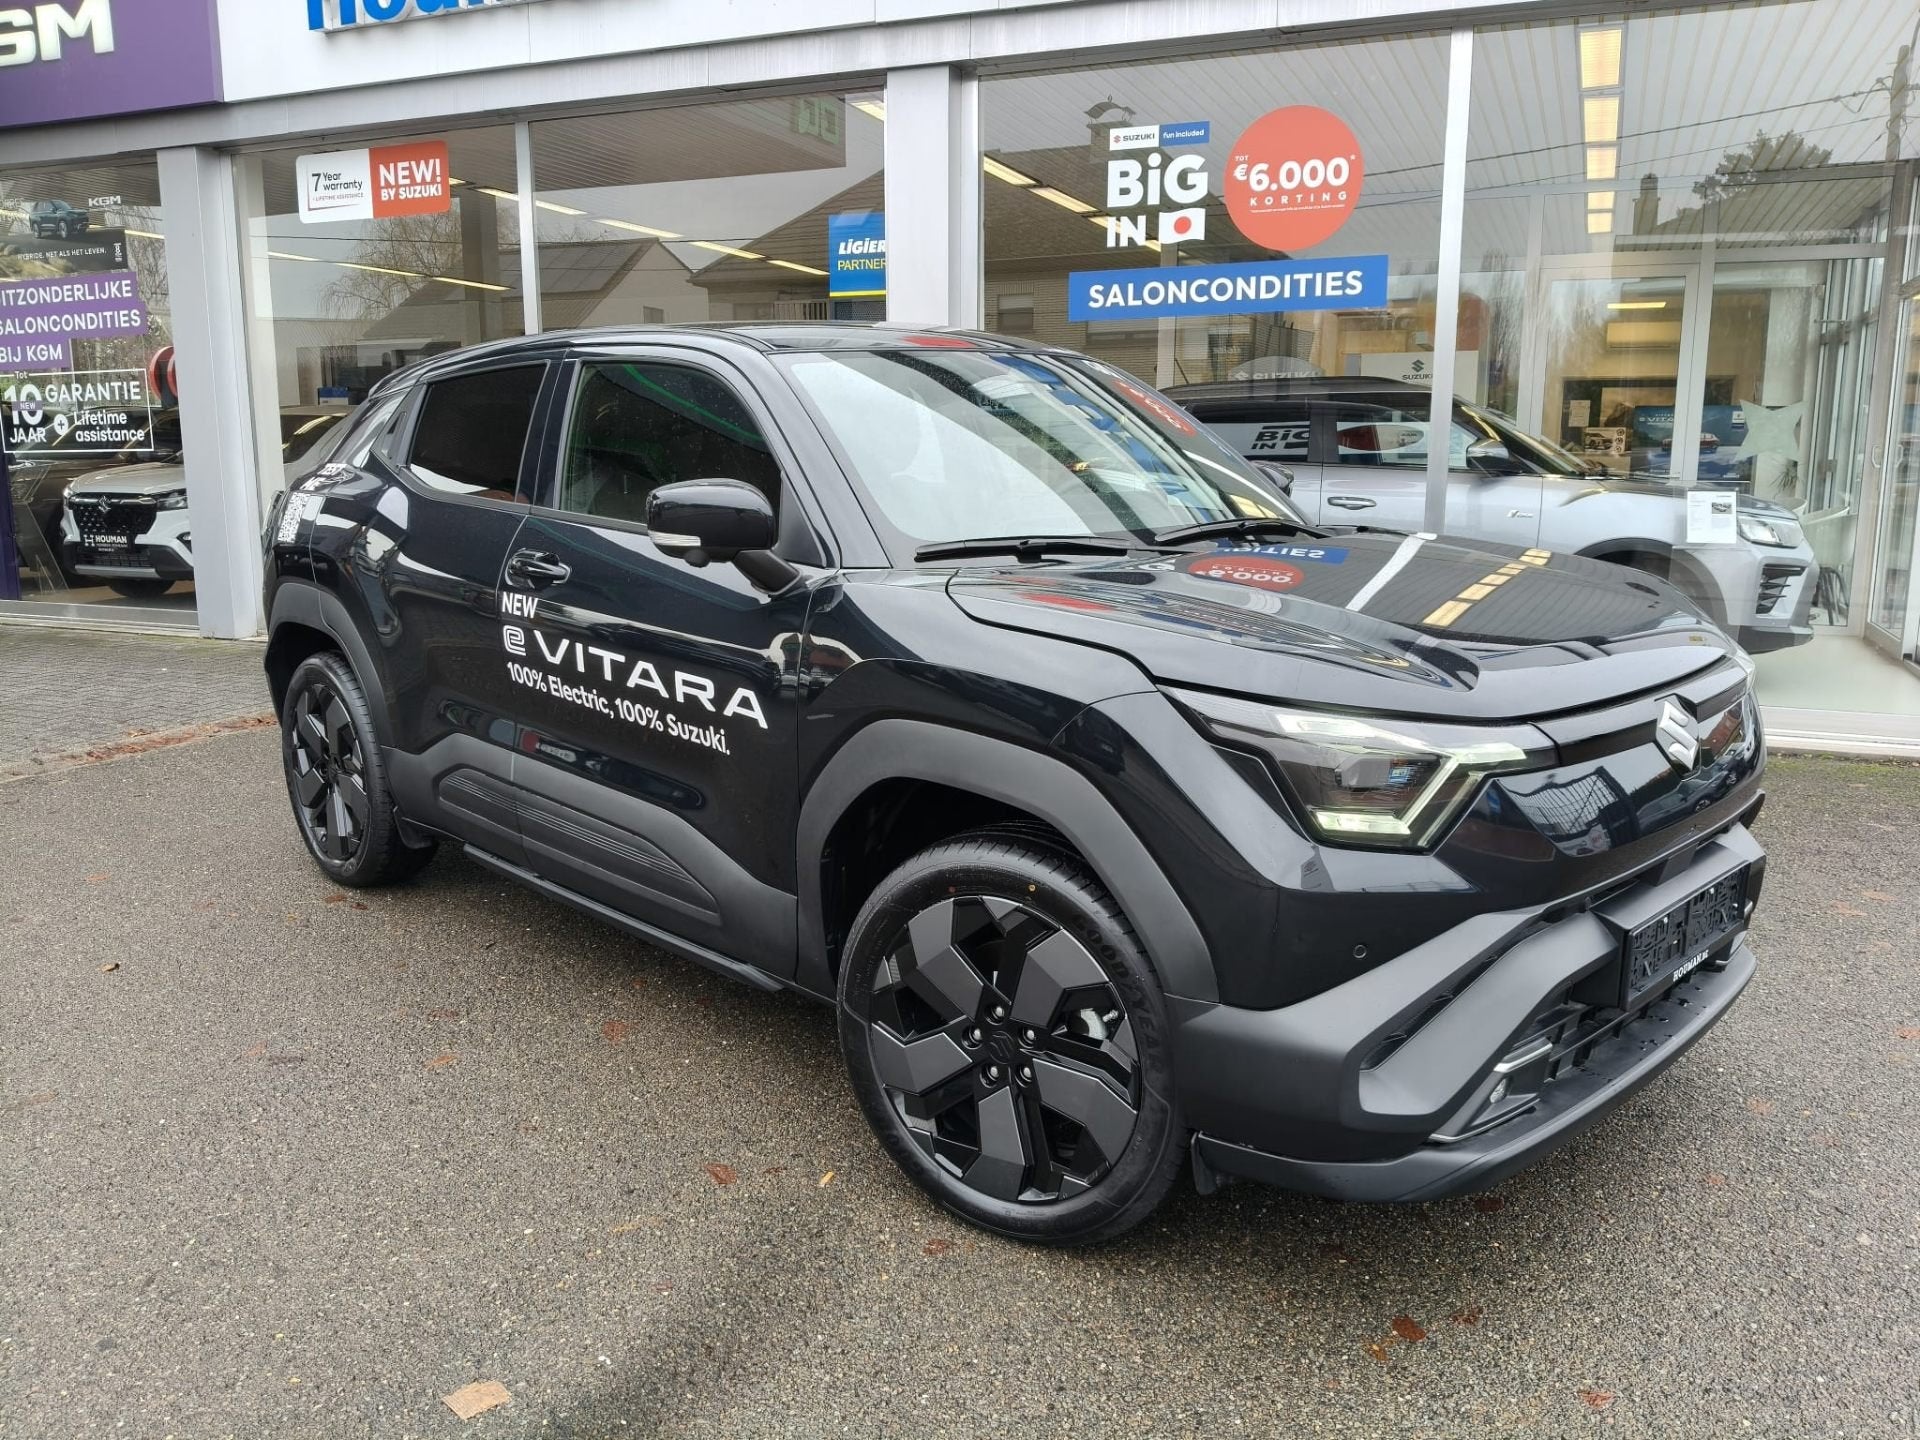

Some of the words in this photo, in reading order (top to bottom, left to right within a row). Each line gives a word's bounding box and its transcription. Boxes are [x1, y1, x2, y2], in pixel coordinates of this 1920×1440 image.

[1123, 133, 1155, 142] SUZUKI
[312, 173, 322, 192] 7
[323, 172, 341, 181] Year
[379, 159, 442, 187] NEW!
[1107, 152, 1208, 208] BiG
[323, 181, 363, 192] warranty
[381, 187, 397, 201] BY
[399, 185, 442, 200] SUZUKI
[88, 195, 121, 207] KGM
[1250, 191, 1347, 206] KORTING
[1107, 215, 1147, 248] IN
[72, 248, 83, 256] HET
[838, 258, 886, 271] PARTNER
[0, 280, 132, 306] ITZONDERLIJKE
[1088, 270, 1363, 308] SALONCONDITIES
[0, 309, 141, 335] SALONCONDITIES
[0, 346, 21, 363] BIJ
[26, 343, 63, 361] KGM
[15, 371, 28, 380] Tot
[4, 384, 43, 425] 10
[45, 381, 141, 402] GARANTIE
[20, 402, 36, 410] NEW
[74, 410, 127, 426] Lifetime
[10, 427, 47, 443] JAAR
[76, 429, 145, 442] assistance
[95, 535, 127, 544] HOUMAN
[502, 591, 538, 618] NEW
[534, 629, 768, 729] VITARA
[507, 661, 548, 693] 100%
[548, 674, 615, 719] Electric,
[615, 698, 664, 732] 100%
[666, 713, 731, 755] Suzuki.
